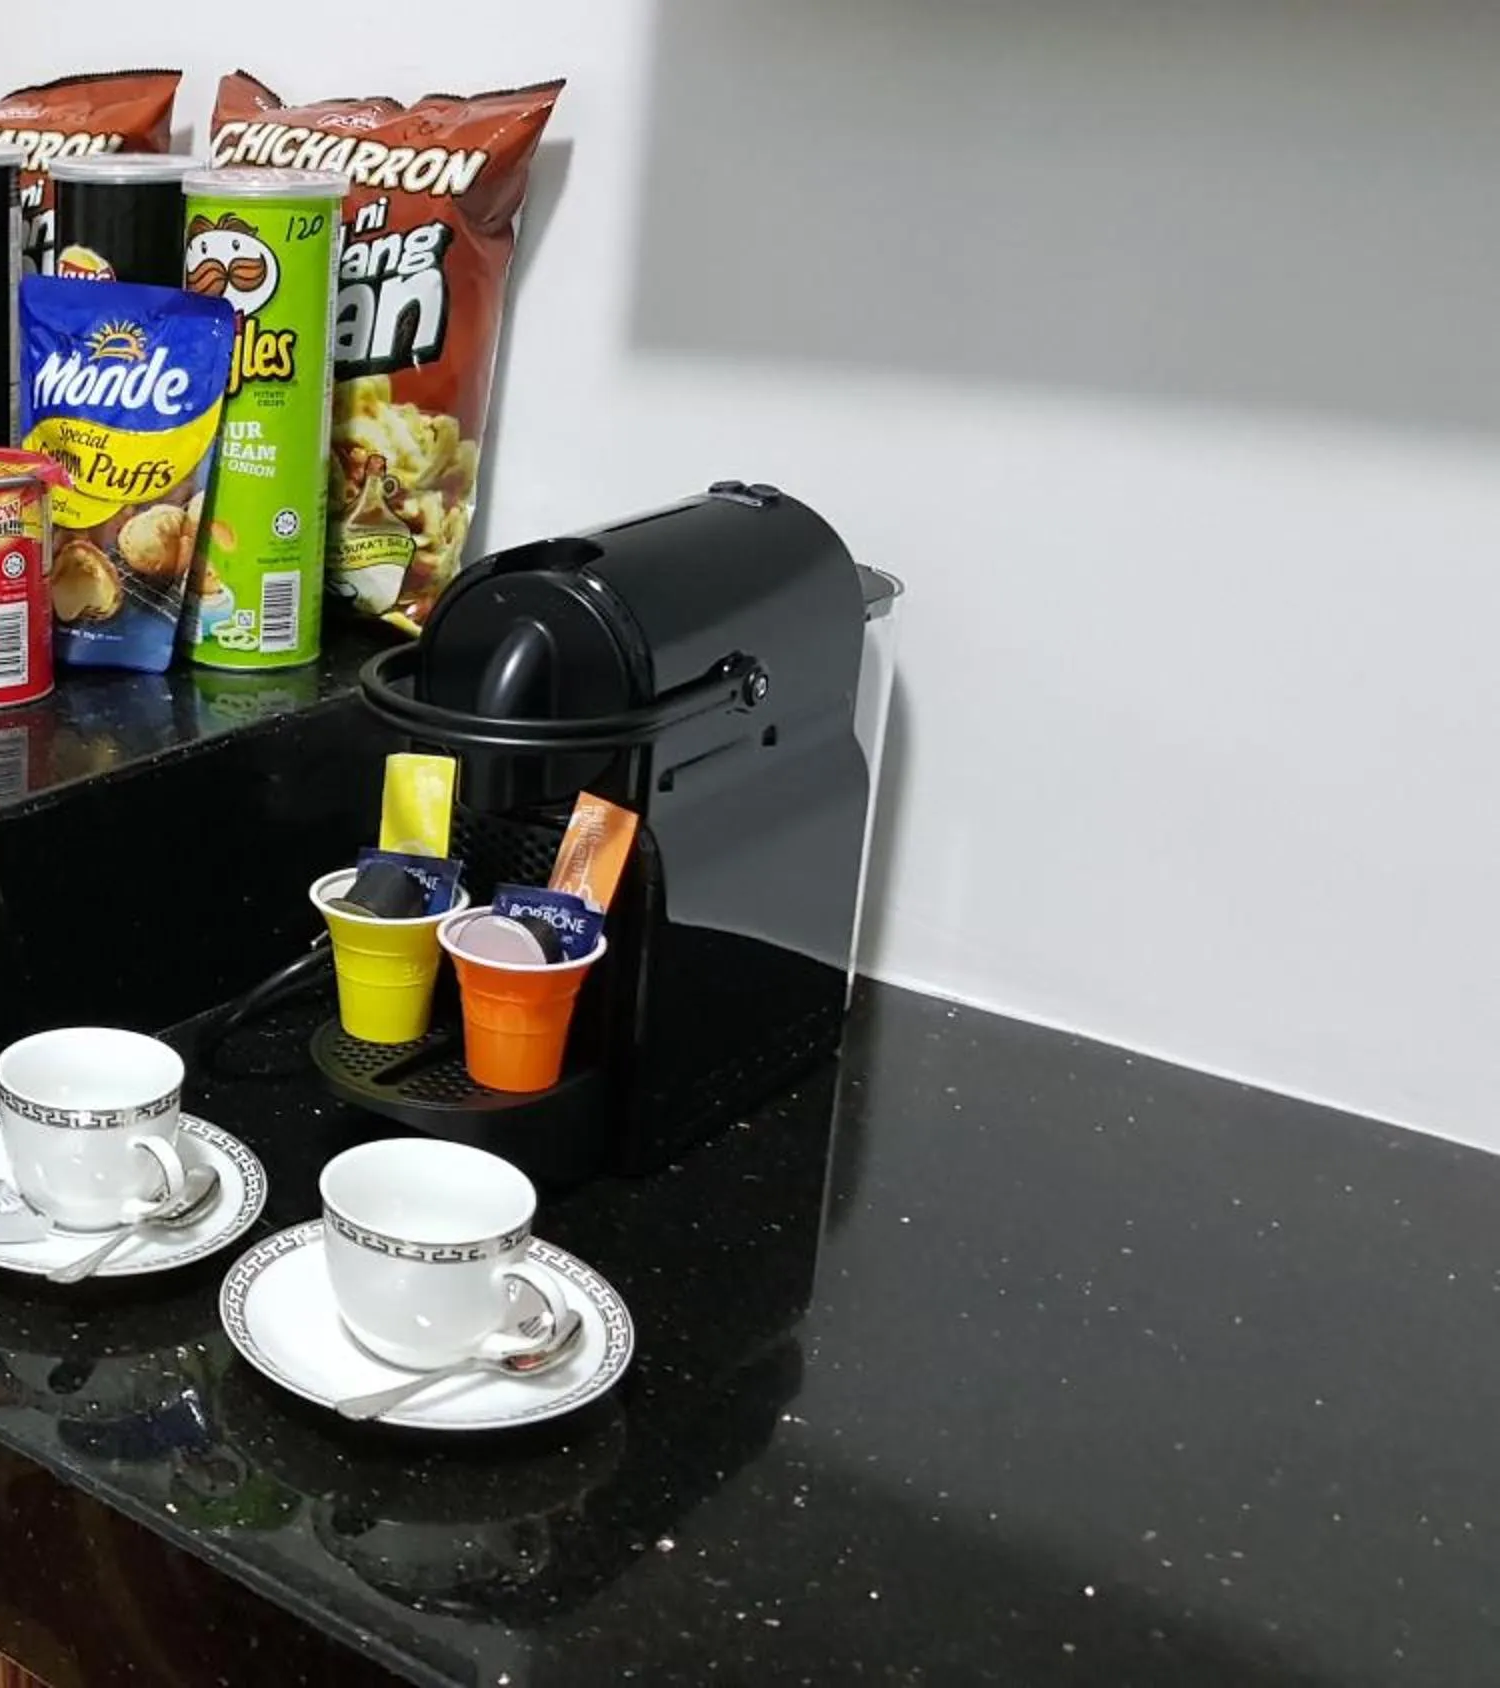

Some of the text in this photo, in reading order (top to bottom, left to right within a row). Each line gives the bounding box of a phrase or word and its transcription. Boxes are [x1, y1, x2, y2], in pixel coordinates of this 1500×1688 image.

[212, 123, 487, 196] CHICHARRON
[286, 214, 325, 243] 120
[355, 197, 388, 233] ni
[339, 222, 446, 280] ang
[334, 267, 443, 360] an
[33, 346, 190, 415] Monde
[59, 421, 110, 450] Special
[224, 421, 263, 440] UR
[222, 441, 277, 462] EAM
[228, 459, 277, 478] ONION
[86, 452, 175, 496] Puffs
